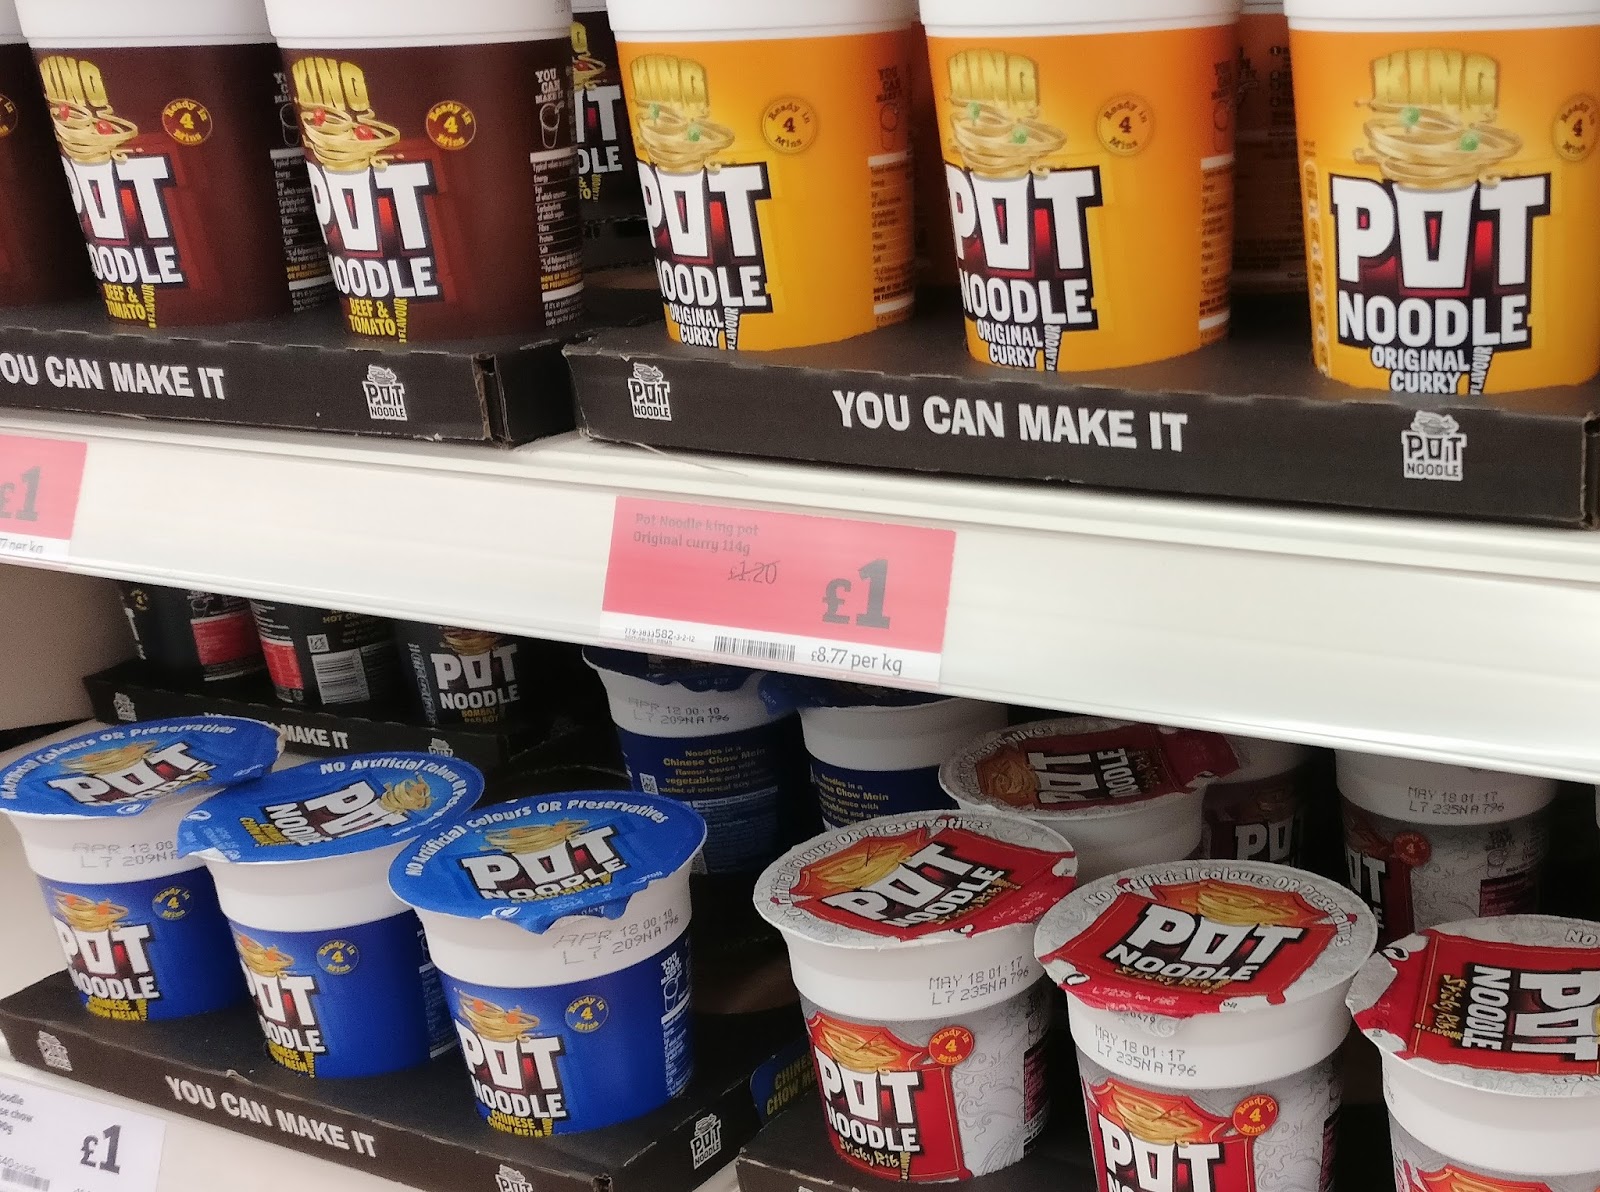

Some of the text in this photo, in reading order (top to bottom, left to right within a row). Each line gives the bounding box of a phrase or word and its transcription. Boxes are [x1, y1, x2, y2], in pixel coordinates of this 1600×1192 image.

[535, 68, 556, 83] YOU
[541, 80, 560, 94] CAN
[947, 50, 1038, 107] KING
[1373, 48, 1499, 110] KING
[164, 99, 195, 117] Ready
[429, 102, 460, 121] Ready
[767, 101, 800, 121] Ready
[1103, 100, 1137, 121] Ready
[180, 113, 194, 129] 4
[444, 116, 458, 133] 4
[783, 118, 796, 134] 4
[1119, 116, 1132, 133] 4
[1573, 119, 1583, 137] 4
[174, 130, 202, 142] Mins
[437, 134, 465, 147] Mins
[775, 135, 802, 148] Mins
[1109, 136, 1138, 149] Mins
[306, 161, 428, 250] POT
[637, 160, 764, 257] POT
[945, 164, 1095, 270] POT
[1331, 174, 1546, 289] POT
[87, 246, 183, 284] OODLE
[104, 284, 138, 303] BEEF &
[961, 269, 1092, 324] NOODLE
[106, 300, 146, 321] TOMATO
[349, 298, 388, 318] BEEF &
[669, 304, 724, 328] ORIGINAL
[1339, 291, 1528, 349] NOODLE
[349, 314, 395, 336] TOMATO
[679, 325, 718, 347] CURRY
[727, 306, 739, 350] FLAVOUR
[976, 319, 1043, 348] ORIGINAL
[989, 343, 1036, 367] CURRY
[1045, 324, 1061, 371] FLAVOUR
[1372, 345, 1470, 371] ORIGINAL
[45, 355, 226, 400] CAN MAKE IT
[1391, 370, 1460, 394] CURRY
[1470, 346, 1493, 395] FLAVOUR
[363, 379, 404, 407] POT
[629, 378, 670, 406] POT
[370, 405, 407, 420] NOODLE
[633, 404, 671, 420] NOODLE
[833, 389, 1188, 452] YOU CAN MAKE IT
[1404, 432, 1464, 462] POT
[1405, 463, 1460, 477] NOODLE
[636, 512, 759, 537] Pot Noodle king pot
[633, 531, 751, 556] Original curry 114g
[822, 559, 891, 629] £1
[430, 644, 518, 690] POT
[811, 646, 903, 676] £8.77 per kg
[439, 684, 520, 710] NOODLE
[38, 731, 126, 764] Colours OR
[281, 724, 349, 749] MAKE IT
[48, 742, 199, 804] POT
[320, 756, 425, 775] NO Artificial
[664, 755, 738, 766] Chinese Chow
[1027, 752, 1100, 804] POT
[836, 787, 860, 799] Chow
[1407, 785, 1436, 800] MAY
[1442, 791, 1457, 803] 18
[305, 780, 407, 838] POT
[466, 806, 531, 828] Colours
[537, 800, 562, 813] OR
[567, 799, 669, 824] Preservatives
[1409, 801, 1505, 813] L7 796
[836, 816, 992, 847] OR Preservatives
[414, 825, 466, 864] Artificial
[1405, 842, 1415, 854] 4
[406, 862, 423, 877] NO
[460, 826, 617, 890] POT
[482, 857, 627, 900] NOODLE
[822, 842, 974, 920] POT
[1085, 867, 1301, 909] NO Artificial OR
[167, 897, 179, 909] 4
[882, 866, 1005, 928] NOODLE
[53, 916, 150, 975] POT
[1127, 903, 1304, 964] POT
[319, 941, 344, 957] Ready
[331, 950, 343, 963] 4
[661, 951, 678, 968] YOU
[1106, 944, 1260, 981] NOODLE
[929, 970, 985, 990] MAY 18
[931, 968, 1030, 1006] L7 796
[568, 996, 596, 1014] Ready
[581, 1006, 593, 1020] 4
[1462, 965, 1512, 1051] NOODLE
[1511, 970, 1600, 1061] POT
[575, 1020, 599, 1030] Mins
[932, 1028, 961, 1045] Ready
[945, 1040, 957, 1053] 4
[1094, 1024, 1137, 1054] MAY 18
[455, 1019, 560, 1090] POT
[938, 1052, 963, 1064] Mins
[1096, 1041, 1198, 1078] L7 796
[471, 1075, 566, 1118] NOODLE
[814, 1046, 919, 1124] POT
[766, 1082, 799, 1116] CHOW
[1238, 1097, 1275, 1115] Ready in
[165, 1075, 377, 1158] YOU CAN MAKE IT
[491, 1109, 535, 1128] CHINESE
[826, 1101, 921, 1152] NOODLE
[1241, 1123, 1266, 1134] Mins
[1249, 1109, 1261, 1123] 4
[81, 1124, 121, 1175] £1
[692, 1119, 721, 1156] POT
[693, 1143, 721, 1167] NOODLE
[838, 1135, 874, 1166] Sticky
[1097, 1113, 1220, 1192] POT
